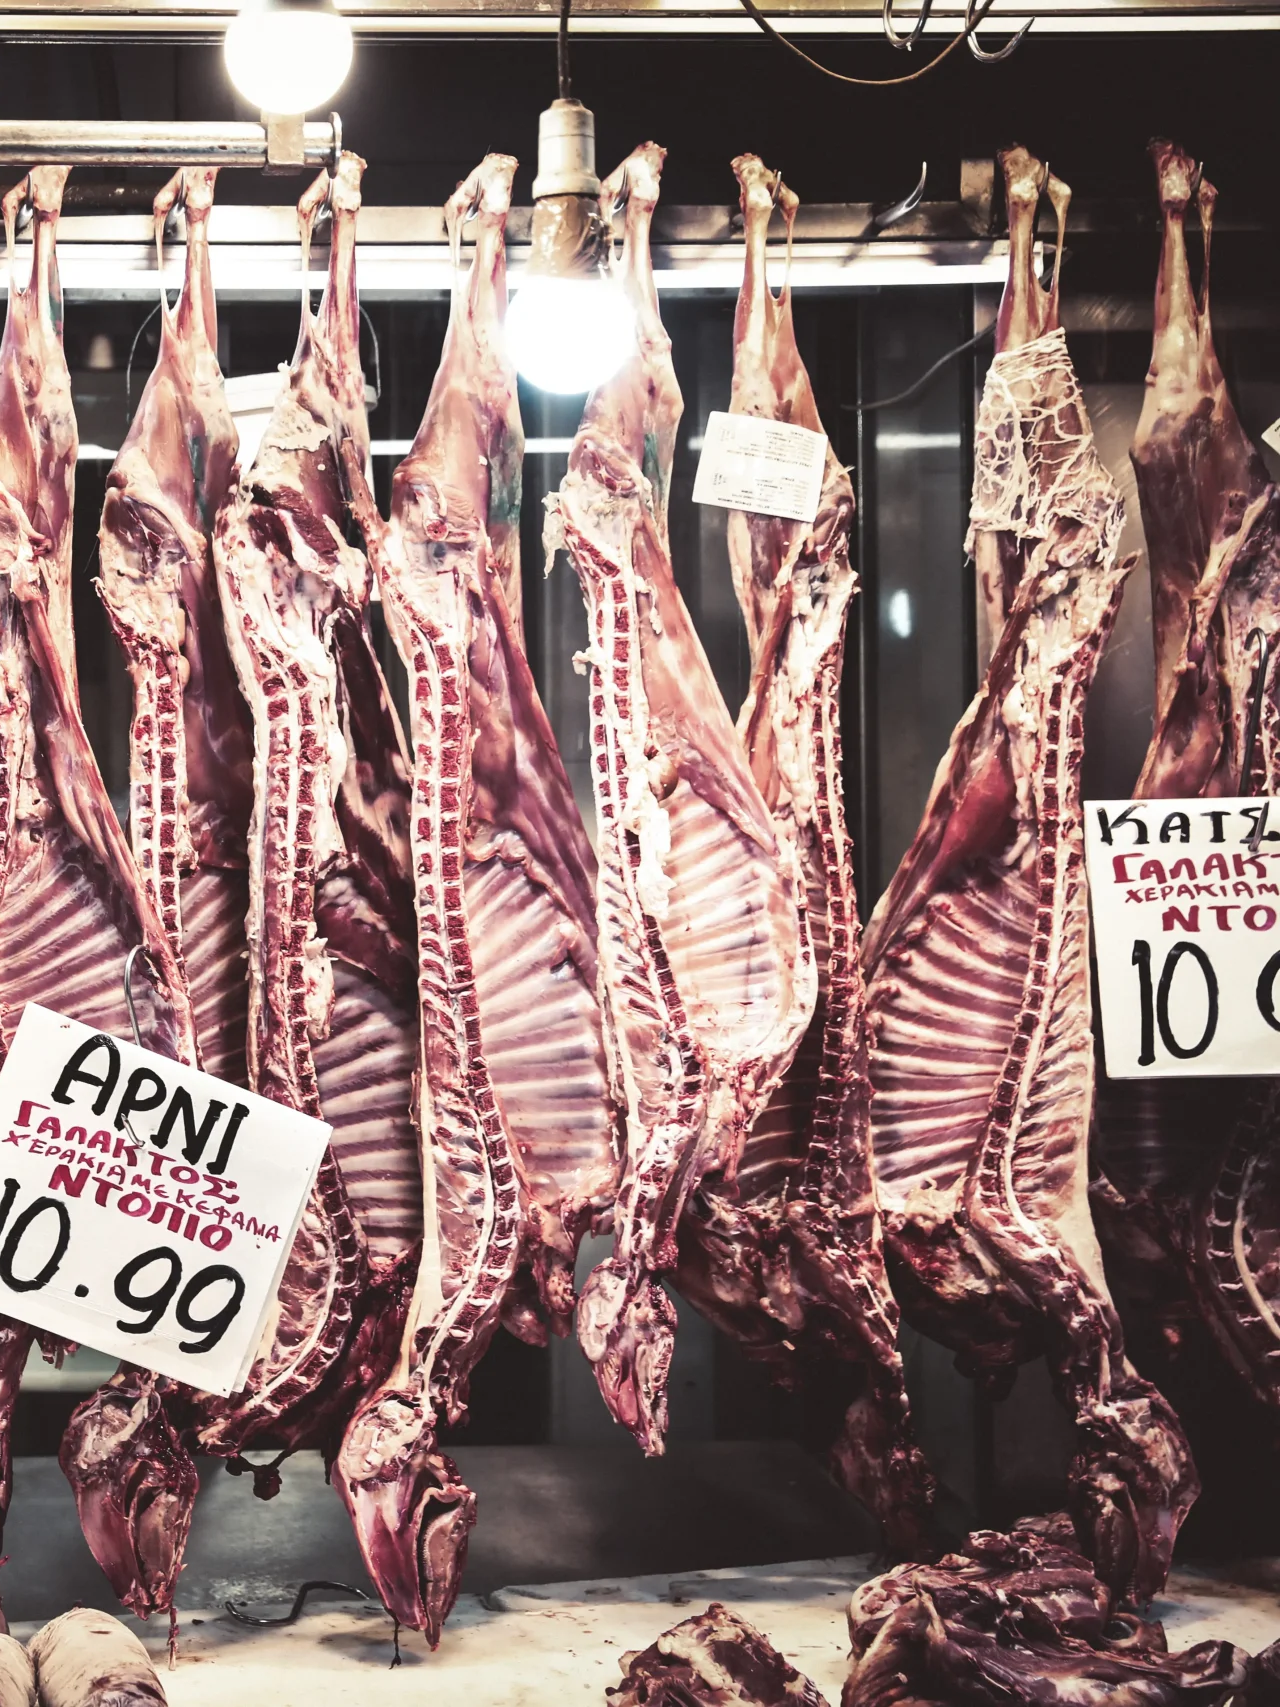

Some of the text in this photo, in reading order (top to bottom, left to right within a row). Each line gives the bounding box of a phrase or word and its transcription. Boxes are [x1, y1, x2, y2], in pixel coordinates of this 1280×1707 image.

[13, 1100, 240, 1204] ΓΑΛΑΚΤΟΣ
[51, 1033, 250, 1175] ΑΡΝΙ
[48, 1164, 233, 1252] ΝΤΟΠΙΟ
